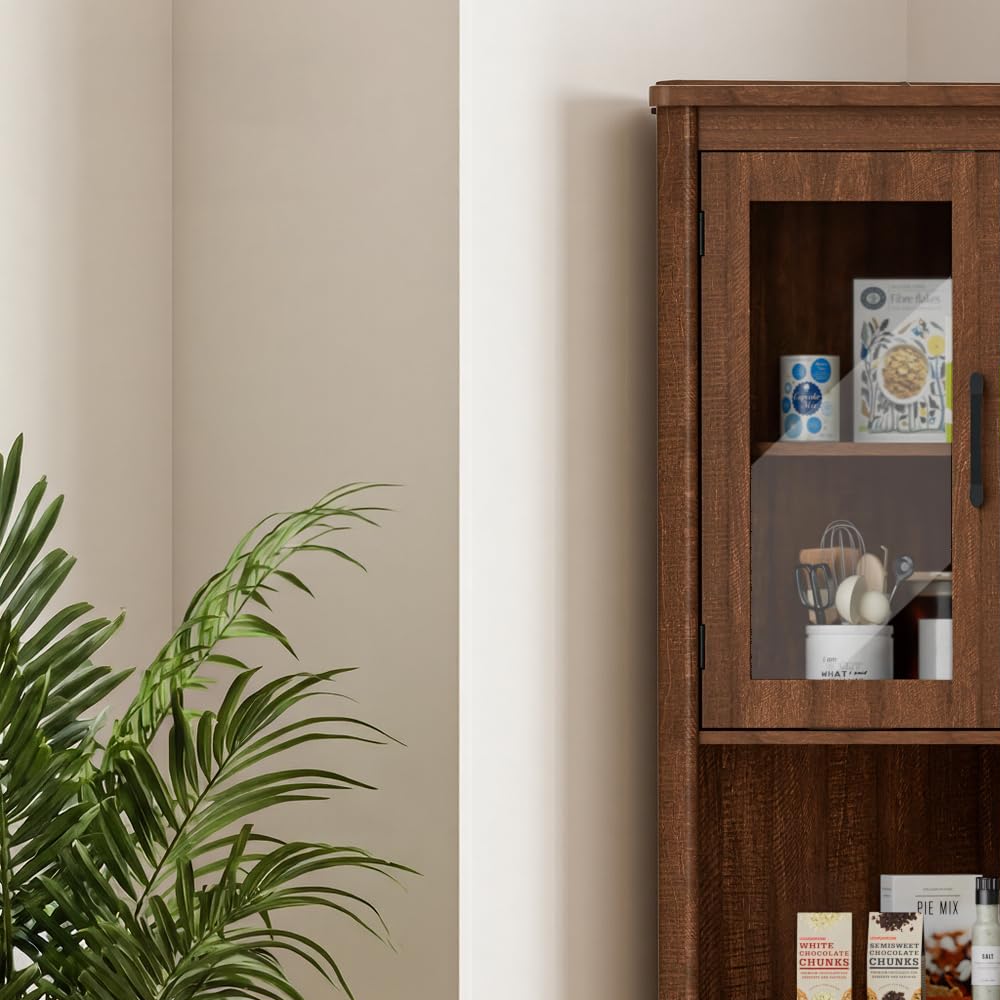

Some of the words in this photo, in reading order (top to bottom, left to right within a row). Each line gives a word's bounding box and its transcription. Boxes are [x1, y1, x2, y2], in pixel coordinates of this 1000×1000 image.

[821, 670, 847, 678] WHAT
[917, 900, 934, 915] PIE
[939, 900, 959, 915] MIX
[799, 958, 850, 967] CHUNKS
[869, 957, 919, 966] CHUNKS
